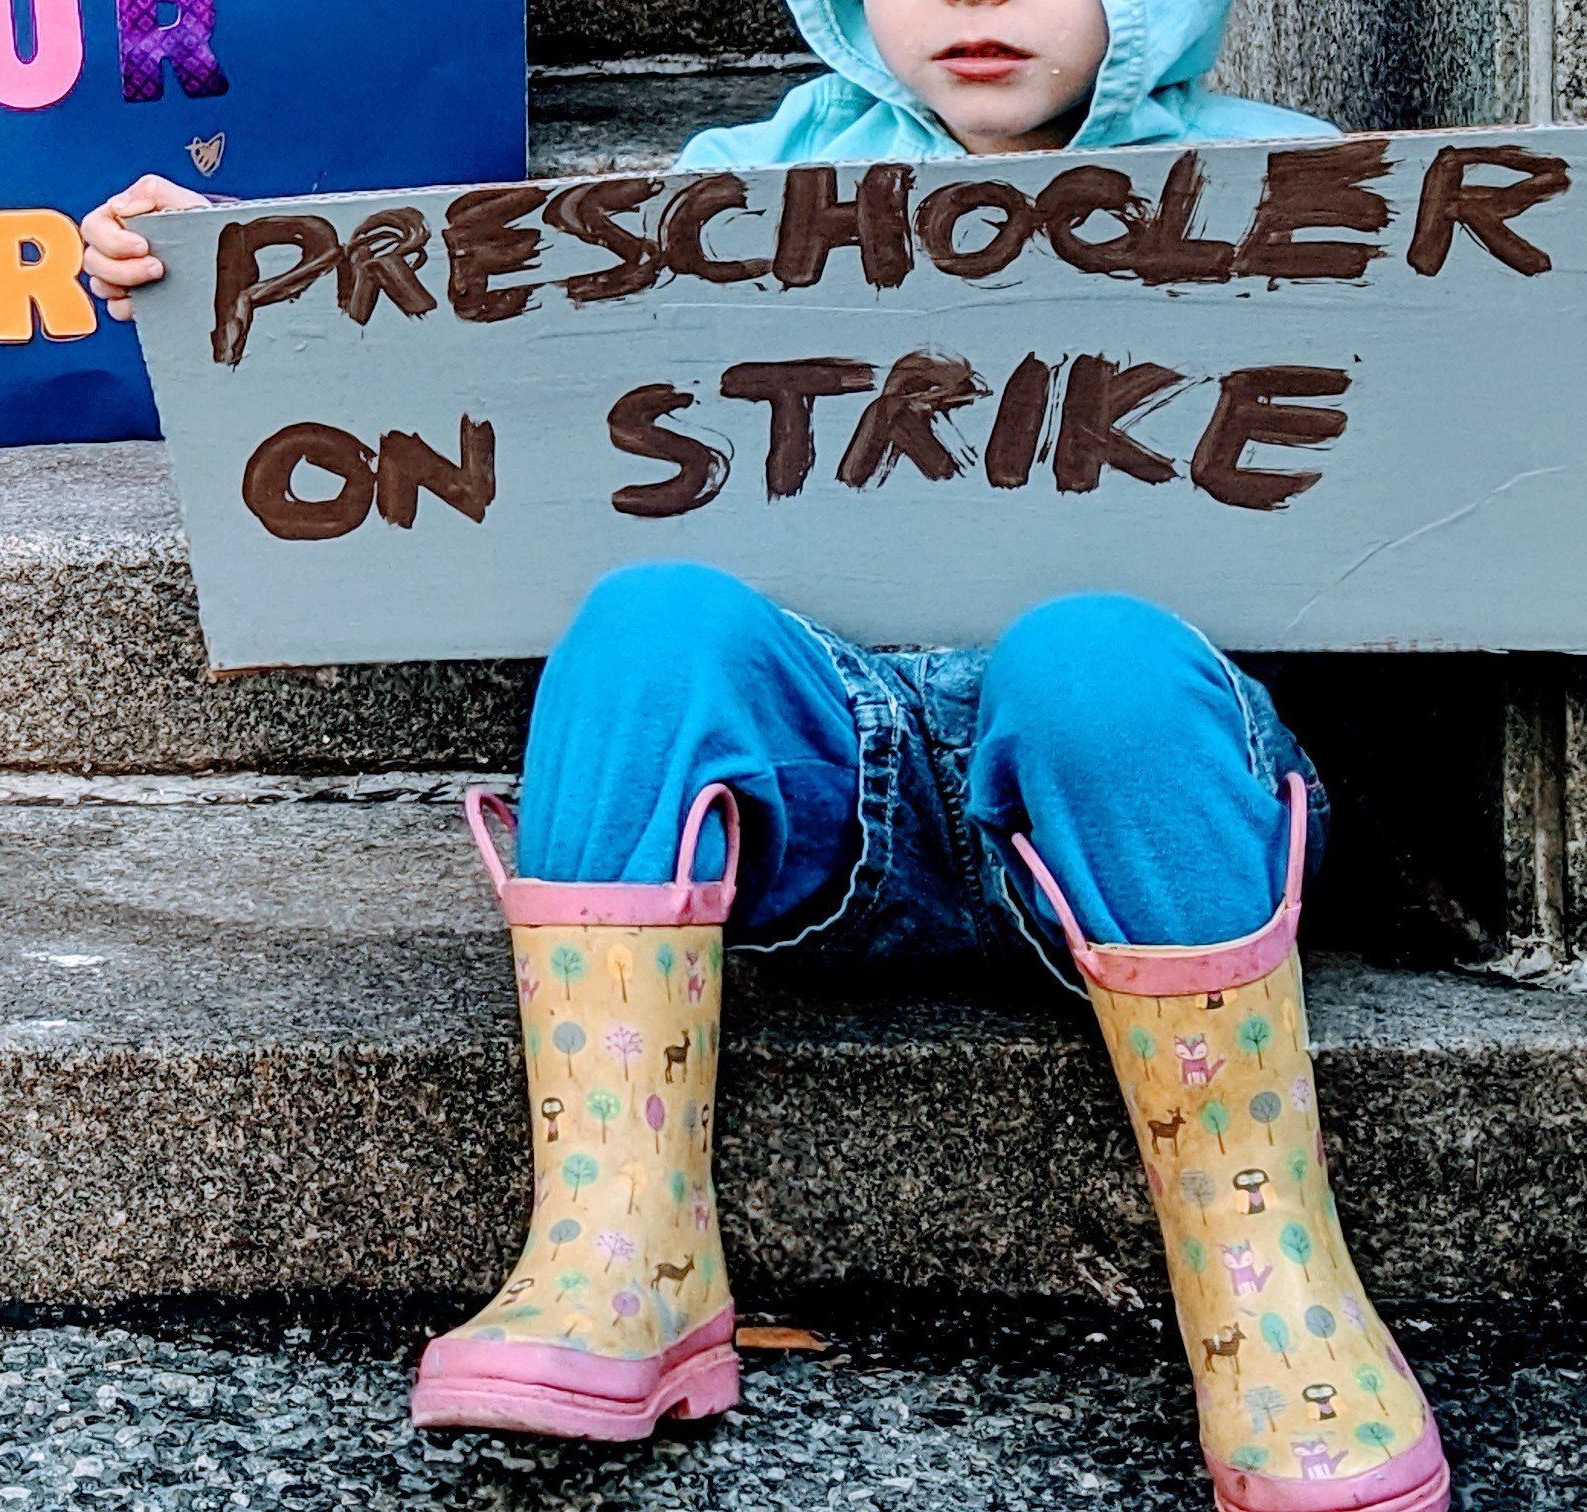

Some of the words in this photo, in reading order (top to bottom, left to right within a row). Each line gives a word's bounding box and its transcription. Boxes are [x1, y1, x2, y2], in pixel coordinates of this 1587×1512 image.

[212, 138, 1574, 367] PRESCHOOLER
[241, 413, 496, 541] ON
[609, 346, 1354, 519] STRIKE
